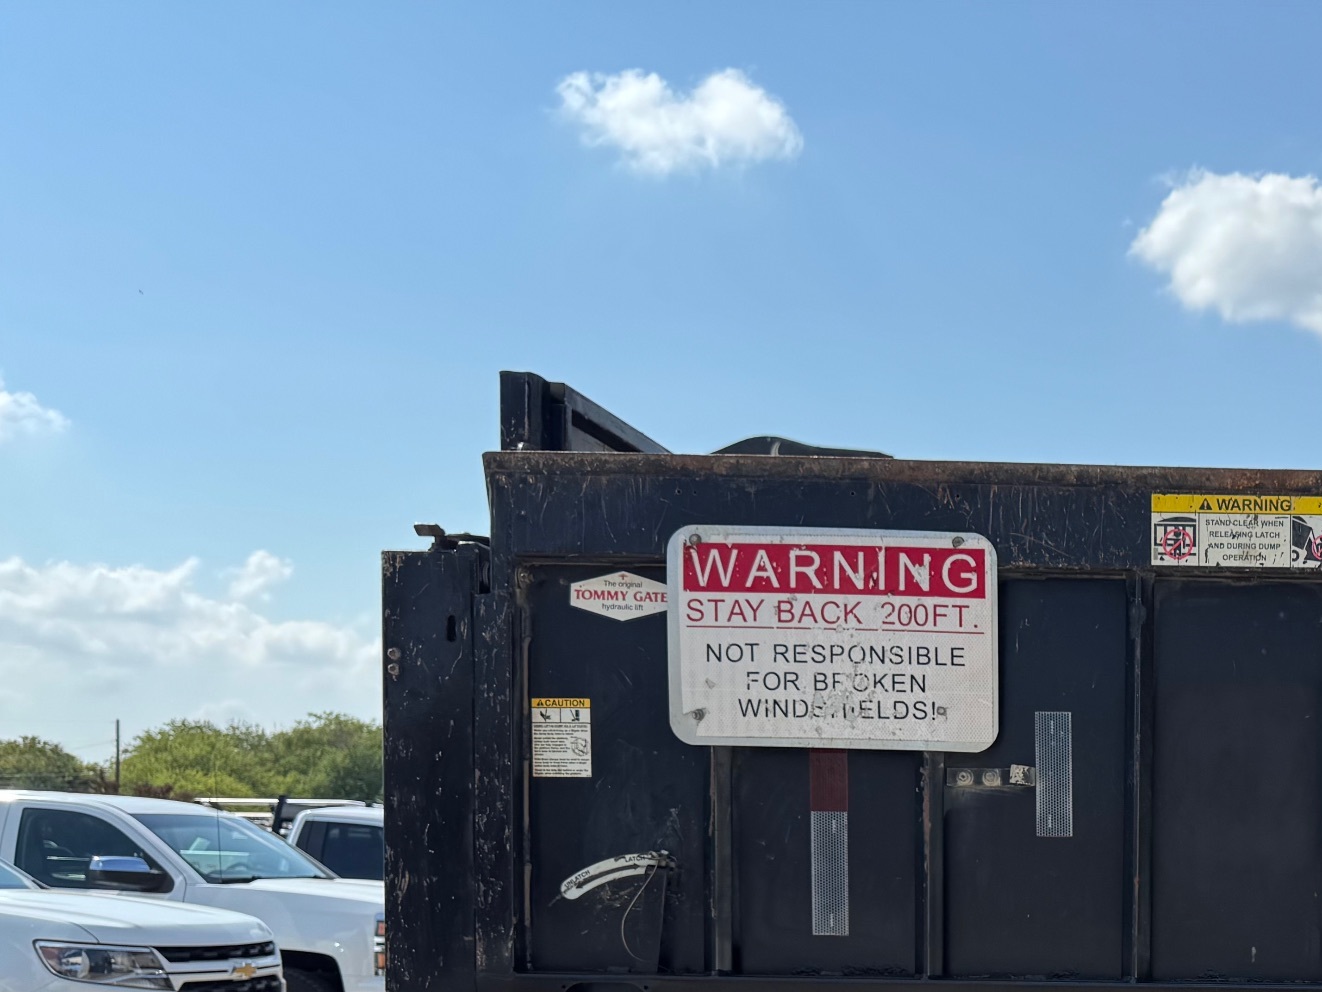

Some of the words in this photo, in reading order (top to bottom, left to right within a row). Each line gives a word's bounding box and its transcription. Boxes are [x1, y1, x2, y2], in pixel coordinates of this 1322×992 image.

[1216, 498, 1291, 512] WARNING
[1205, 519, 1231, 527] STAND
[1232, 519, 1259, 527] CLEAR
[1261, 520, 1284, 528] WHEN
[1209, 530, 1253, 538] RELEASING
[1255, 531, 1280, 539] LATCH
[690, 548, 979, 594] WARNING
[618, 581, 643, 589] original
[574, 589, 628, 601] TOMMY
[633, 591, 668, 602] GATE
[602, 603, 633, 611] hydraulic
[686, 598, 764, 623] STAY
[777, 600, 863, 625] BACK
[881, 602, 978, 628] 200FT.
[706, 643, 760, 663] NOT
[773, 643, 966, 666] RESPONSIBLE
[746, 671, 801, 691] FOR
[545, 699, 585, 707] CAUTION
[564, 870, 591, 888] UNLATCH
